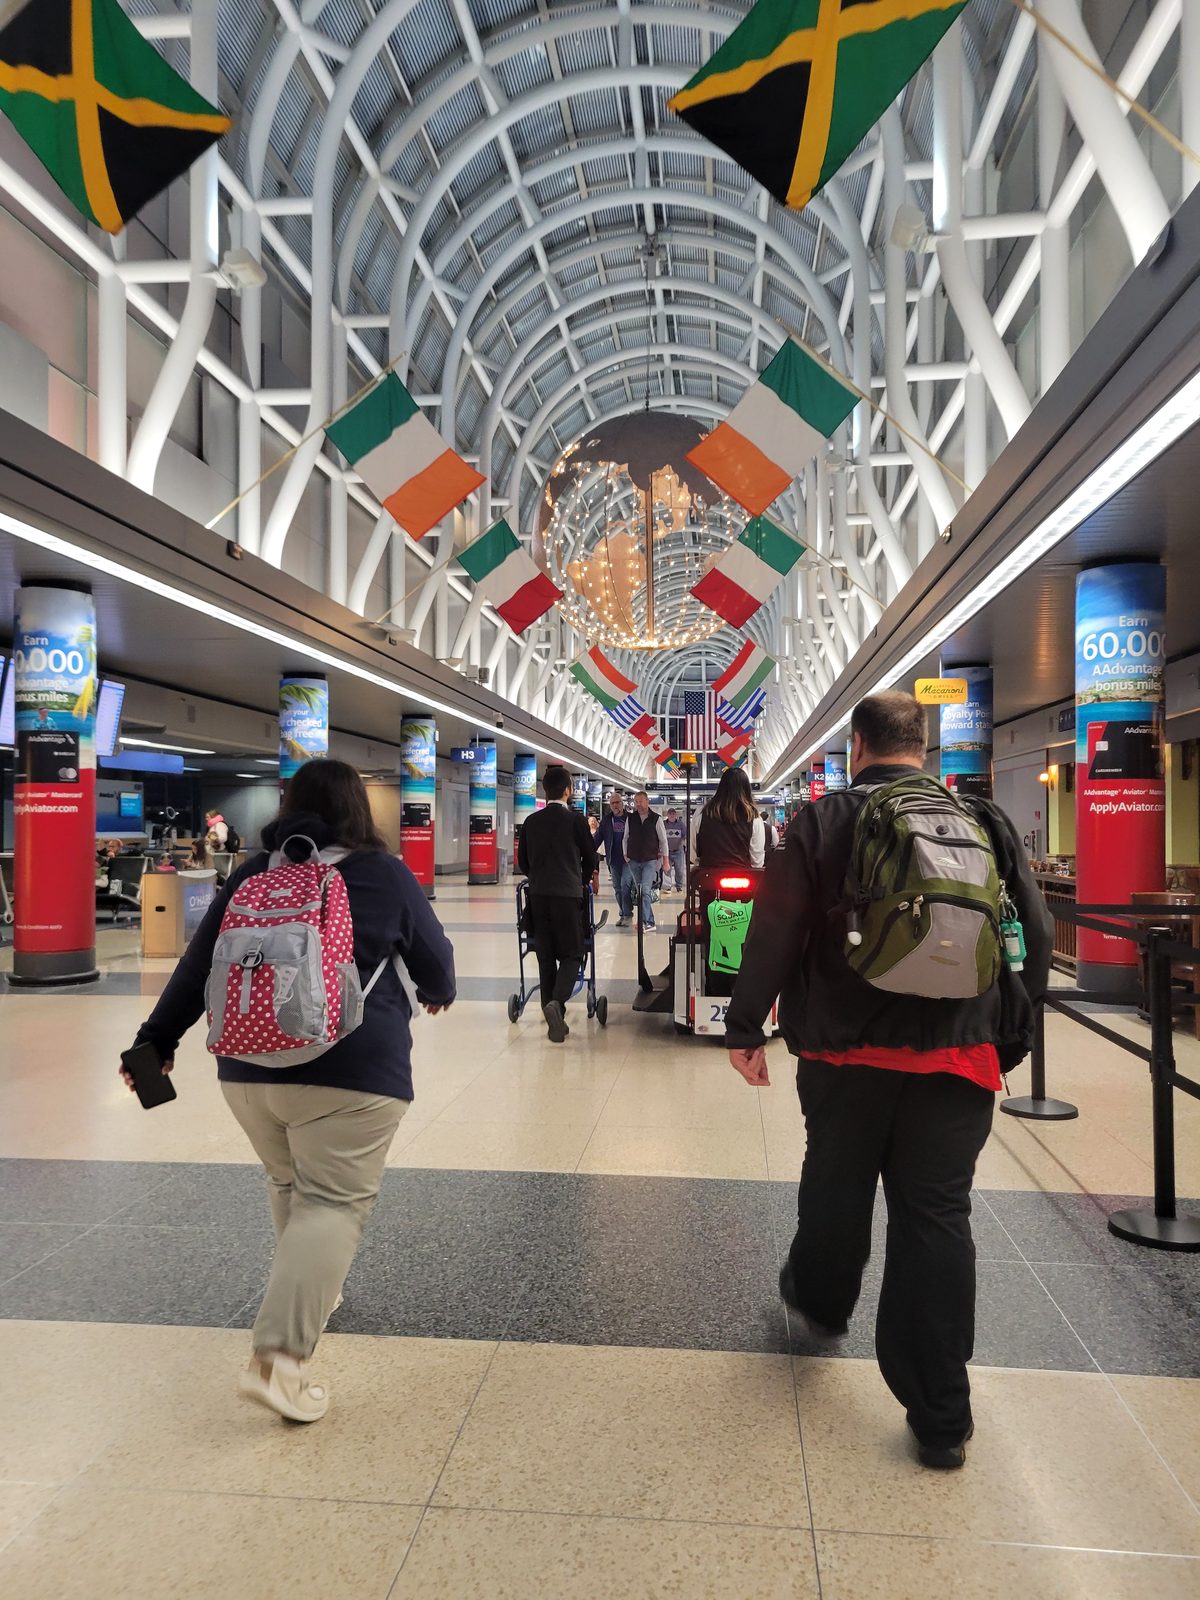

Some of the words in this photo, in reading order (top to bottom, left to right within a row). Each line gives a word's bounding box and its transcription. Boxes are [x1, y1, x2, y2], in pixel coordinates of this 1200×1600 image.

[1119, 616, 1148, 627] Earn
[23, 635, 49, 646] Earn
[1092, 662, 1162, 678] AAdvantage
[920, 684, 964, 694] Macaroni
[1096, 680, 1134, 692] bonus
[38, 690, 69, 703] miles
[944, 708, 974, 721] Loyalty
[286, 718, 323, 728] checked
[943, 720, 973, 730] toward
[461, 750, 475, 760] H3
[814, 773, 825, 781] K2
[717, 910, 744, 921] SQUAD
